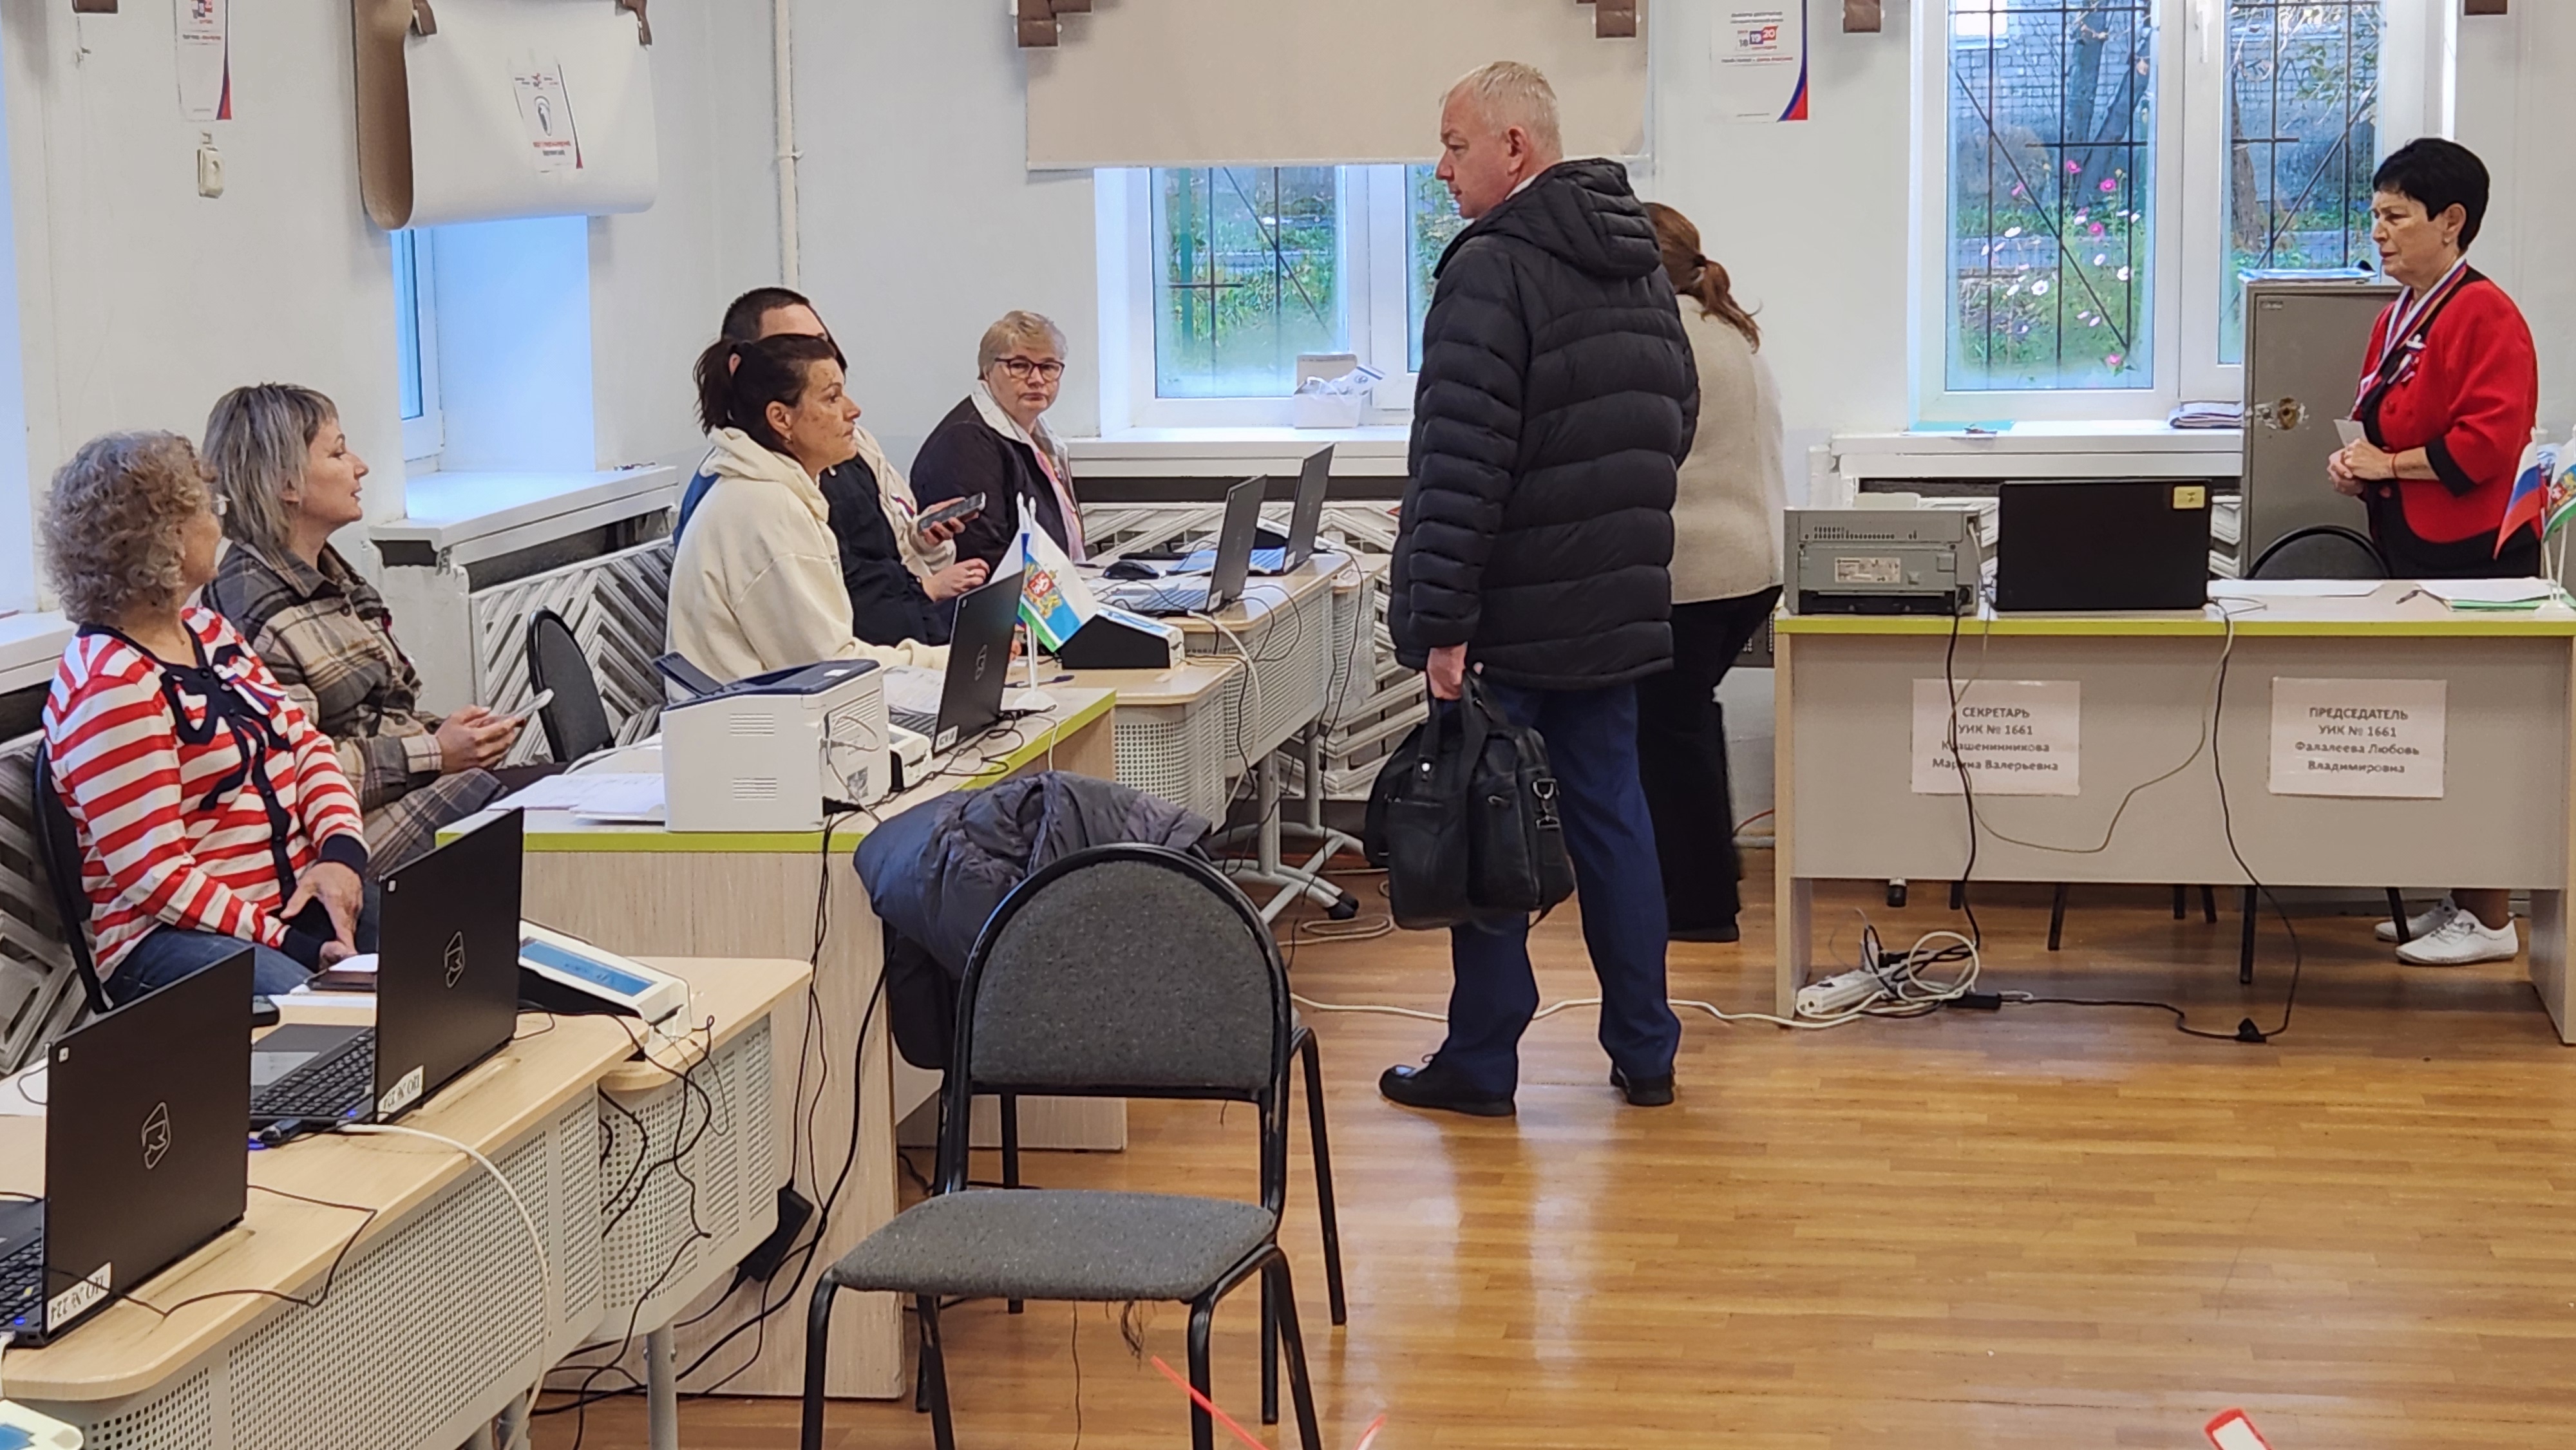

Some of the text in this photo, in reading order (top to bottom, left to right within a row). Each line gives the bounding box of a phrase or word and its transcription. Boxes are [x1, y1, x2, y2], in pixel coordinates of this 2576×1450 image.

[1751, 33, 1762, 42] 19
[1762, 28, 1776, 39] 20
[1962, 707, 2031, 719] СЕКРЕТАРЬ
[2309, 707, 2409, 720] ПРЕДСЕДАТЕЛЬ
[1958, 724, 2033, 735] УИК № 1661
[2318, 725, 2397, 737] УИК № 1661
[1942, 740, 2050, 752] Кашенинникова
[2295, 741, 2420, 755] Фалалеева Любовь
[1932, 758, 2058, 772] Марна Валерьевна
[2307, 760, 2405, 774] Владимировна
